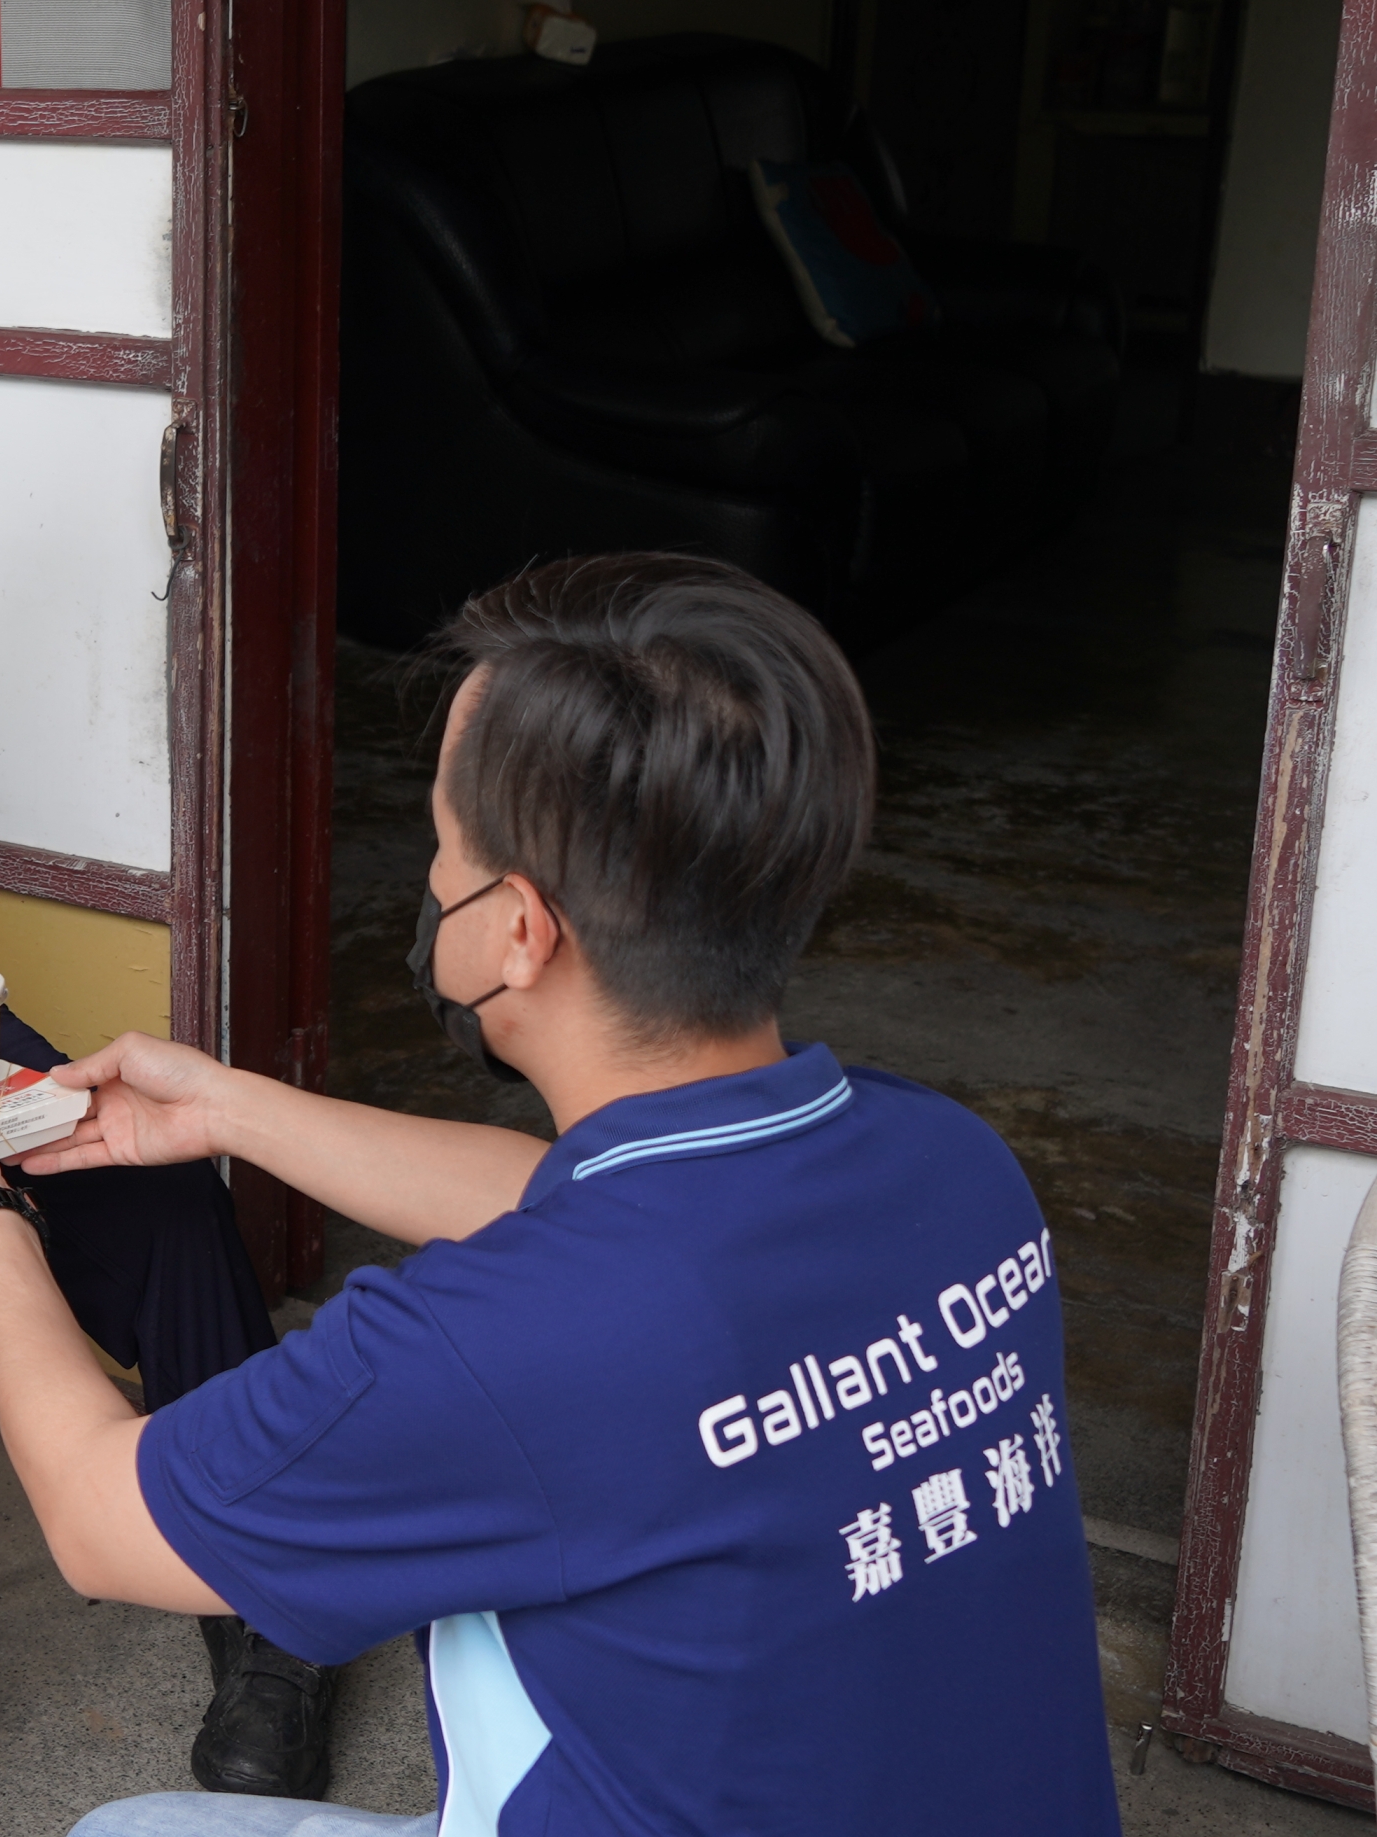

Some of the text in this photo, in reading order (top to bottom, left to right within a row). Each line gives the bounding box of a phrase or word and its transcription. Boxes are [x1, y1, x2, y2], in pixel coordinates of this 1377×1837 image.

[698, 1314, 938, 1468] Gallant
[861, 1352, 1025, 1472] Seafoods
[838, 1393, 1062, 1602] 嘉豐海洋
